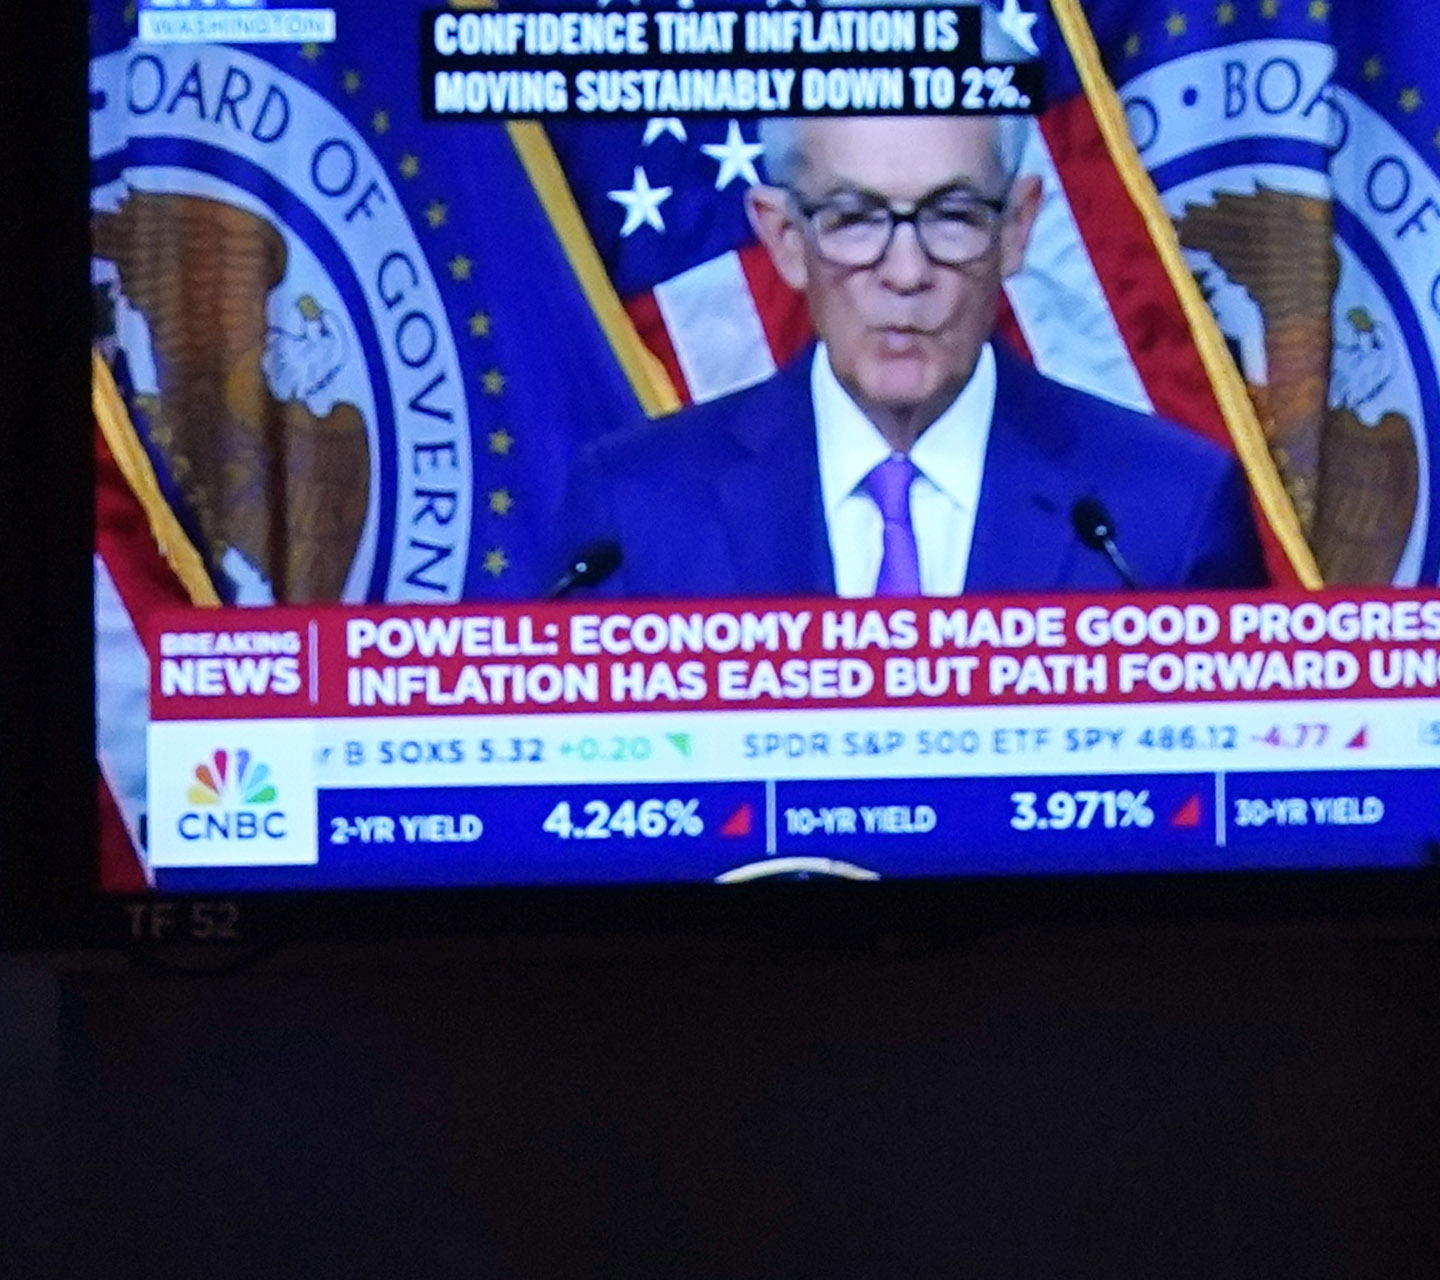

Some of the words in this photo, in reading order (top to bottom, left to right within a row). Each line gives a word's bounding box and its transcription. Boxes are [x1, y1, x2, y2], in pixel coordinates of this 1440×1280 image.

[801, 69, 904, 109] DOWN
[909, 67, 955, 108] TO
[161, 657, 301, 697] NEWS
[347, 662, 599, 707] INFLATION
[610, 660, 708, 703] HAS
[717, 657, 875, 701] EASED
[884, 655, 979, 697] BUT
[989, 652, 1108, 695] PATH
[1118, 648, 1360, 694] FORWARD
[1009, 789, 1155, 831] 3.971%
